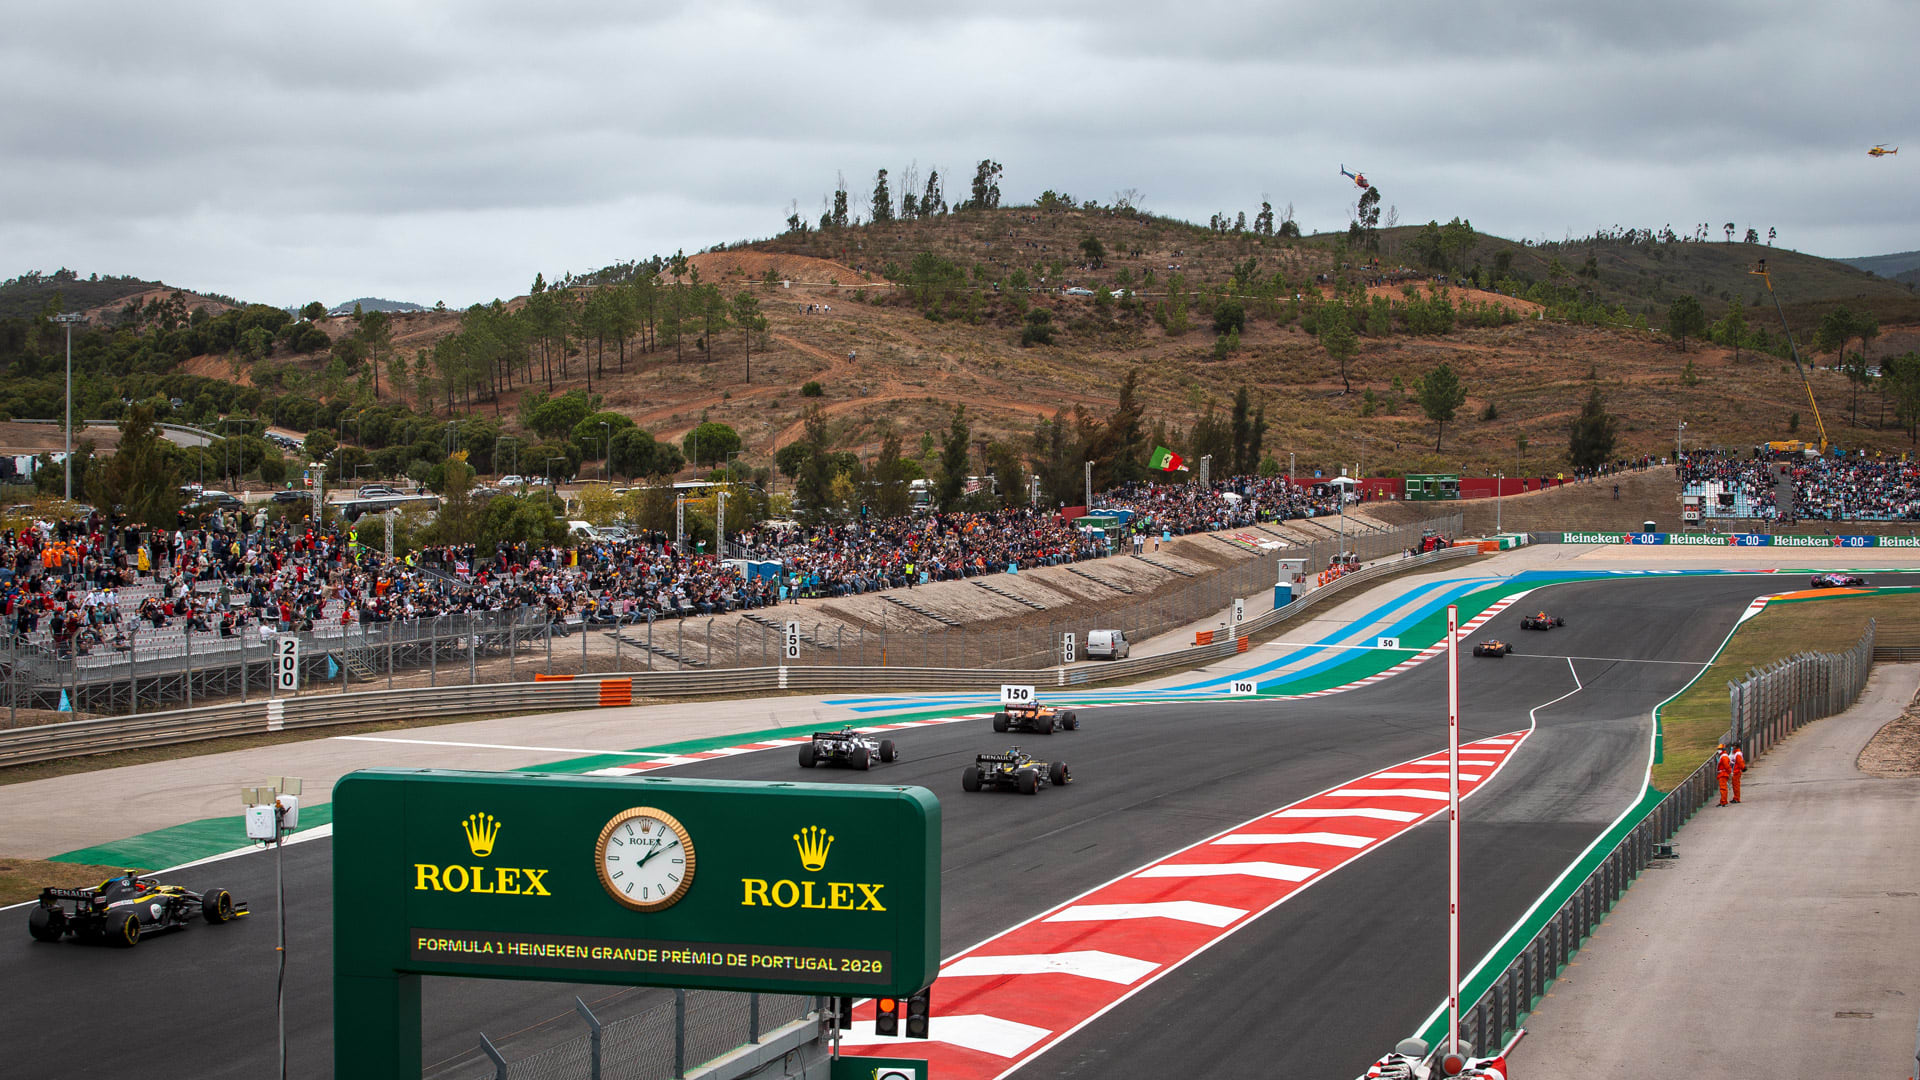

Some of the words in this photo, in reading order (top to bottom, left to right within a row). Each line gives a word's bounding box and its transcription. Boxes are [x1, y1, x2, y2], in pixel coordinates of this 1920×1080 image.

[1563, 533, 1620, 544] Heineken
[1669, 533, 1725, 545] Heineken
[1774, 536, 1829, 547] Heineken
[1236, 606, 1243, 621] 50
[788, 623, 798, 657] 150
[1383, 639, 1393, 647] 50
[282, 640, 295, 687] 200
[1235, 683, 1252, 692] 100
[1007, 688, 1028, 700] 150
[414, 863, 552, 897] ROLEX
[50, 888, 94, 899] RENAULT
[741, 878, 887, 912] ROLEX
[418, 938, 494, 954] FORMULA
[496, 942, 505, 955] 1
[508, 943, 589, 959] HEINEKEN
[591, 947, 658, 963] GRANDE
[661, 947, 723, 966] PRÉMIO
[726, 953, 748, 967] DE
[751, 955, 839, 972] PORTUGAL
[841, 958, 883, 974] 2020
